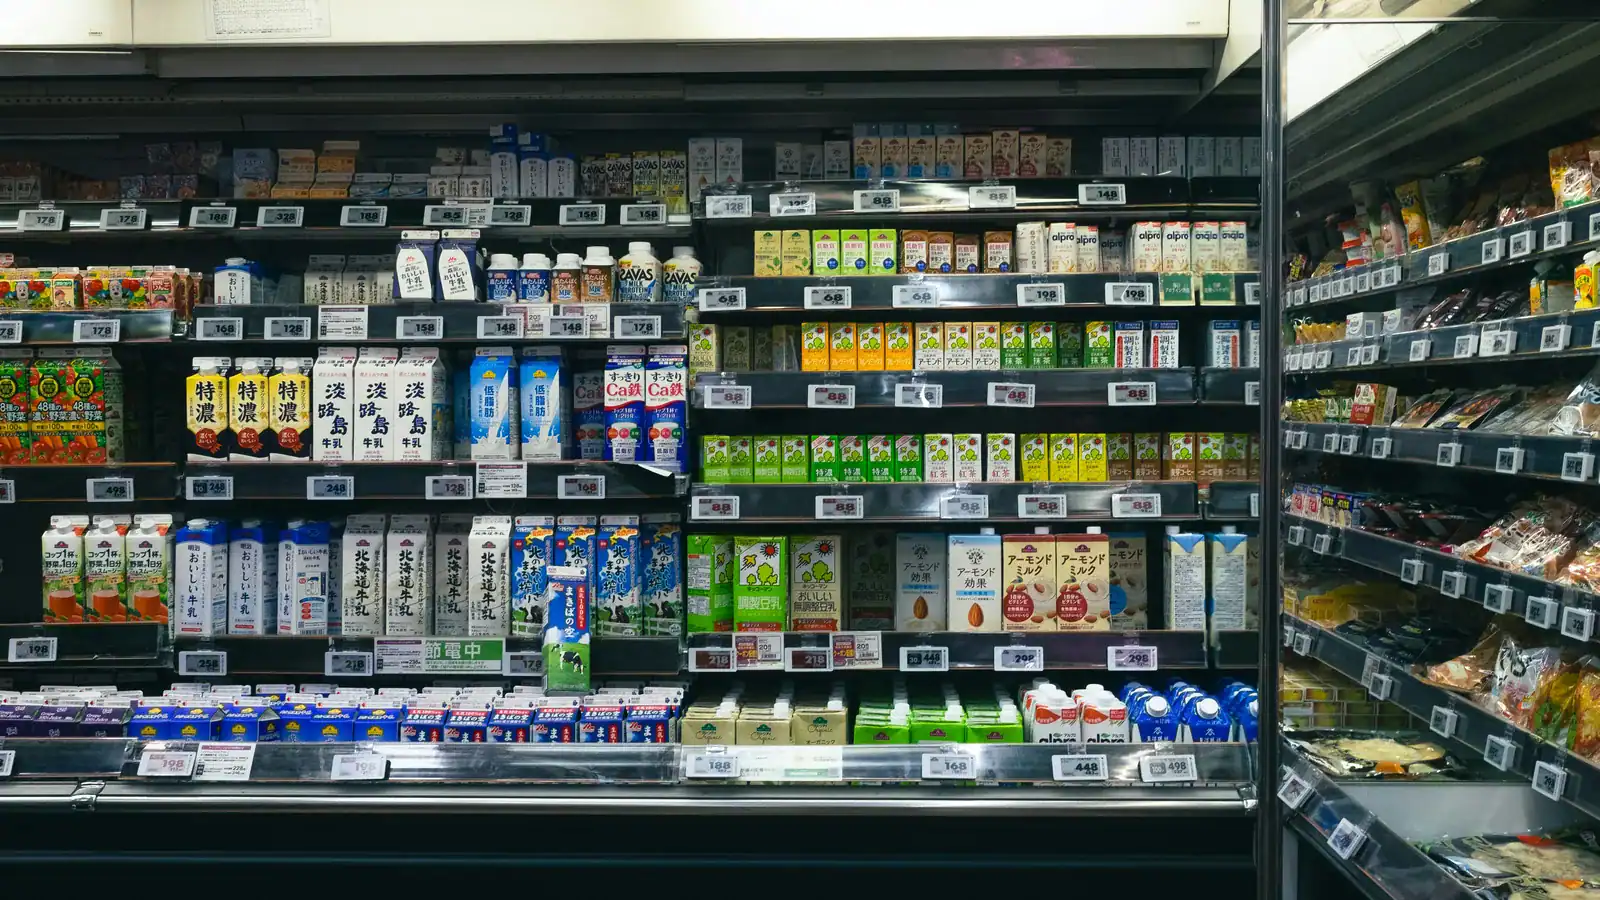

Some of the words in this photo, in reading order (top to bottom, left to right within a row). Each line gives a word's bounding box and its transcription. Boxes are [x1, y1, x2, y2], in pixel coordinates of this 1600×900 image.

[608, 162, 631, 172] SAVAS
[634, 160, 658, 170] SAVAS
[662, 160, 685, 170] SAVAS
[1098, 190, 1118, 198] 148
[873, 196, 892, 205] 88
[725, 202, 743, 211] 128
[209, 213, 228, 222] 188
[276, 212, 295, 221] 328
[360, 212, 378, 220] 188
[443, 210, 462, 220] 85
[504, 210, 522, 220] 128
[578, 210, 597, 218] 158
[639, 210, 658, 218] 158
[1052, 232, 1074, 243] alpro
[1076, 236, 1097, 246] alpro
[1139, 232, 1160, 242] alpro
[1166, 232, 1189, 242] alpro
[1102, 239, 1124, 249] alpro
[620, 268, 654, 282] SAVAS
[664, 272, 697, 286] SAVAS
[406, 277, 422, 285] 牛乳
[448, 278, 466, 286] 牛乳
[719, 294, 738, 302] 68
[824, 293, 843, 302] 68
[1037, 290, 1056, 299] 198
[1126, 290, 1145, 298] 198
[92, 326, 112, 335] 178
[216, 324, 235, 333] 168
[284, 324, 303, 333] 128
[416, 324, 434, 332] 158
[496, 324, 516, 332] 148
[563, 322, 582, 331] 148
[918, 358, 942, 366] アーモンド
[946, 358, 970, 366] アーモンド
[1005, 357, 1024, 366] 抹茶
[1034, 357, 1052, 366] 抹茶
[1090, 356, 1109, 365] 抹茶
[609, 372, 640, 382] すっきり
[650, 372, 682, 382] すっきり
[606, 382, 642, 397] Ca鉄
[648, 382, 684, 397] Ca鉄
[1128, 390, 1148, 398] 88
[828, 392, 847, 400] 88
[1008, 391, 1026, 400] 88
[196, 380, 216, 424] 特濃
[238, 380, 258, 424] 特濃
[278, 380, 298, 424] 特濃
[484, 385, 494, 418] 低脂肪
[535, 384, 546, 418] 低脂肪
[38, 402, 61, 412] 48種の
[73, 402, 97, 412] 48種の
[318, 382, 348, 436] 淡路島
[360, 382, 390, 436] 淡路島
[398, 382, 428, 436] 淡路島
[33, 411, 68, 421] 濃い野菜
[68, 411, 103, 421] 濃い野菜
[322, 438, 342, 448] 牛乳
[363, 438, 384, 448] 牛乳
[402, 438, 422, 448] 牛乳
[816, 468, 832, 477] 特濃
[844, 468, 861, 477] 特濃
[930, 468, 948, 478] 紅茶
[958, 468, 977, 478] 紅茶
[992, 468, 1010, 478] 紅茶
[106, 485, 126, 494] 498
[210, 482, 225, 491] 248
[326, 484, 346, 492] 248
[445, 484, 464, 492] 128
[578, 483, 596, 492] 168
[960, 502, 980, 510] 88
[1038, 502, 1058, 510] 88
[1132, 501, 1152, 510] 88
[44, 550, 78, 558] コップ1杯で
[88, 550, 122, 558] コップ1杯で
[129, 550, 164, 558] コップ1杯で
[1110, 550, 1143, 560] ーモンド
[1008, 554, 1052, 566] アーモンド
[1061, 554, 1106, 566] アーモンド
[656, 543, 672, 598] 北のおいしさ
[903, 562, 940, 572] アーモンド
[1016, 566, 1042, 576] ミルク
[1070, 566, 1096, 576] ミルク
[529, 546, 545, 601] 北のおいしさ
[613, 546, 628, 601] 北のおいしさ
[911, 572, 932, 583] 効果
[957, 568, 996, 578] アーモンド
[187, 552, 199, 618] おいしい牛乳
[238, 551, 250, 616] おいしい牛乳
[354, 549, 370, 617] 北海道牛乳
[398, 549, 414, 617] 北海道牛乳
[446, 549, 462, 614] 北海道牛乳
[480, 552, 496, 620] 北海道牛乳
[518, 560, 534, 603] まる搾り
[604, 560, 617, 603] まる搾り
[964, 578, 987, 589] 効果
[798, 592, 832, 601] おいしい
[738, 596, 782, 610] 調製豆乳
[793, 602, 836, 612] 無調整豆乳
[564, 586, 576, 638] まきばの空
[29, 646, 48, 654] 198
[426, 642, 481, 660] 節電中
[708, 656, 729, 664] 218
[805, 656, 825, 664] 218
[924, 654, 940, 662] 448
[1128, 654, 1148, 663] 298
[162, 760, 184, 768] 198
[709, 760, 730, 770] 188
[945, 762, 966, 770] 168
[1076, 764, 1098, 772] 448
[1168, 762, 1187, 771] 498
